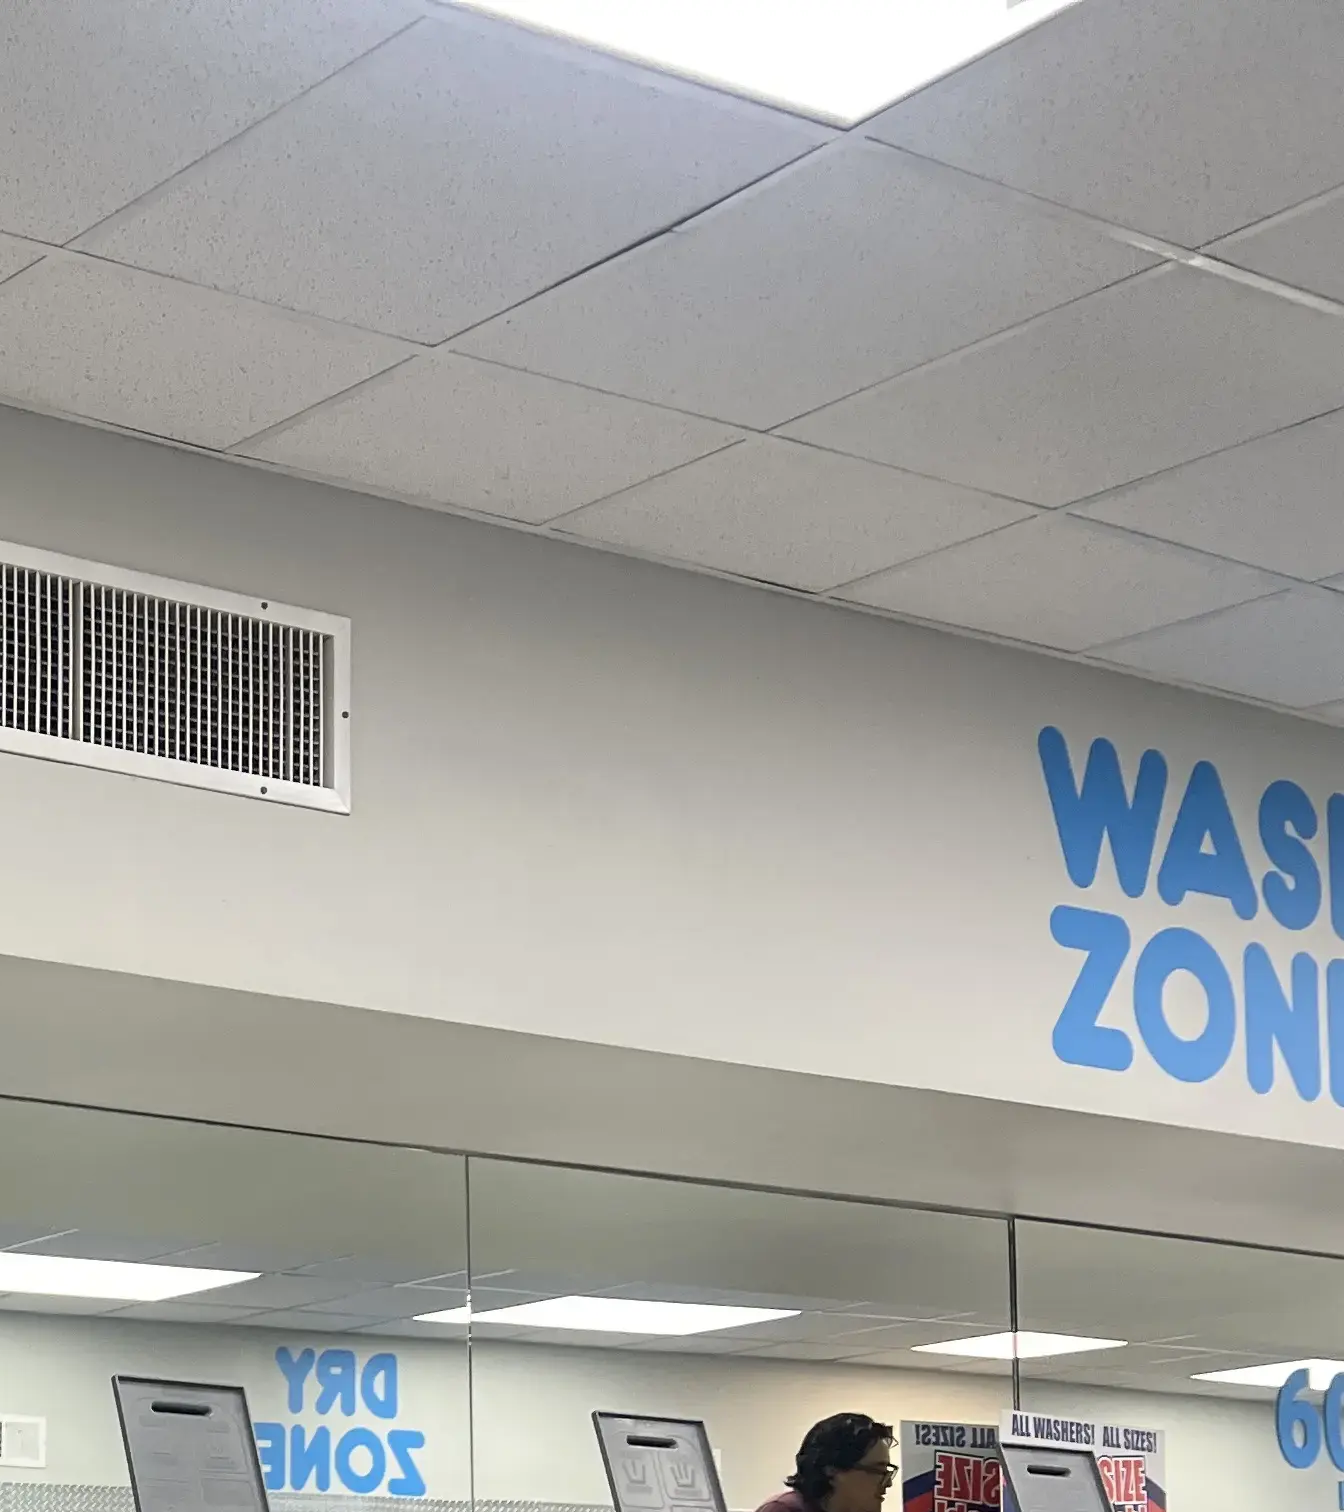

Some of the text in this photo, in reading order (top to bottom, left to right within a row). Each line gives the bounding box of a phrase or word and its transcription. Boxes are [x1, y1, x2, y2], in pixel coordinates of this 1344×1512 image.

[1011, 1413, 1158, 1454] ALL WASHERS! ALL SIZES!
